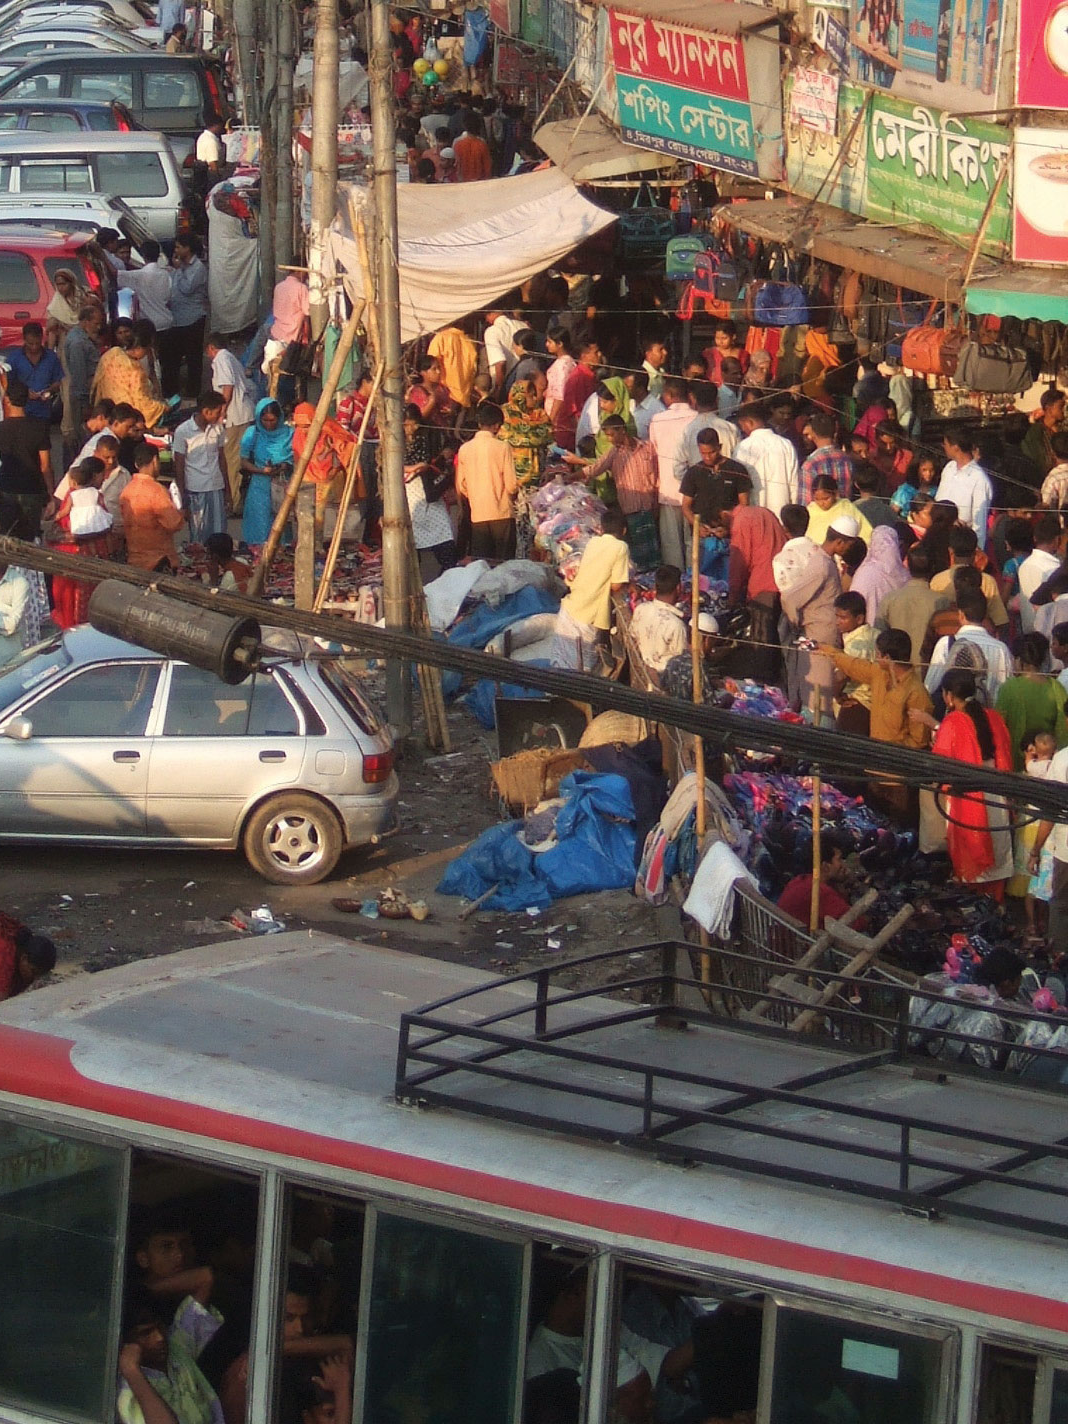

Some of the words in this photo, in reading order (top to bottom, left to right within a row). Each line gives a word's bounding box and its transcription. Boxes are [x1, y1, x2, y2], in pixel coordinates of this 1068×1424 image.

[651, 19, 741, 90] ম্যানসন
[620, 83, 676, 134] শপিং
[680, 101, 751, 152] সেন্টার
